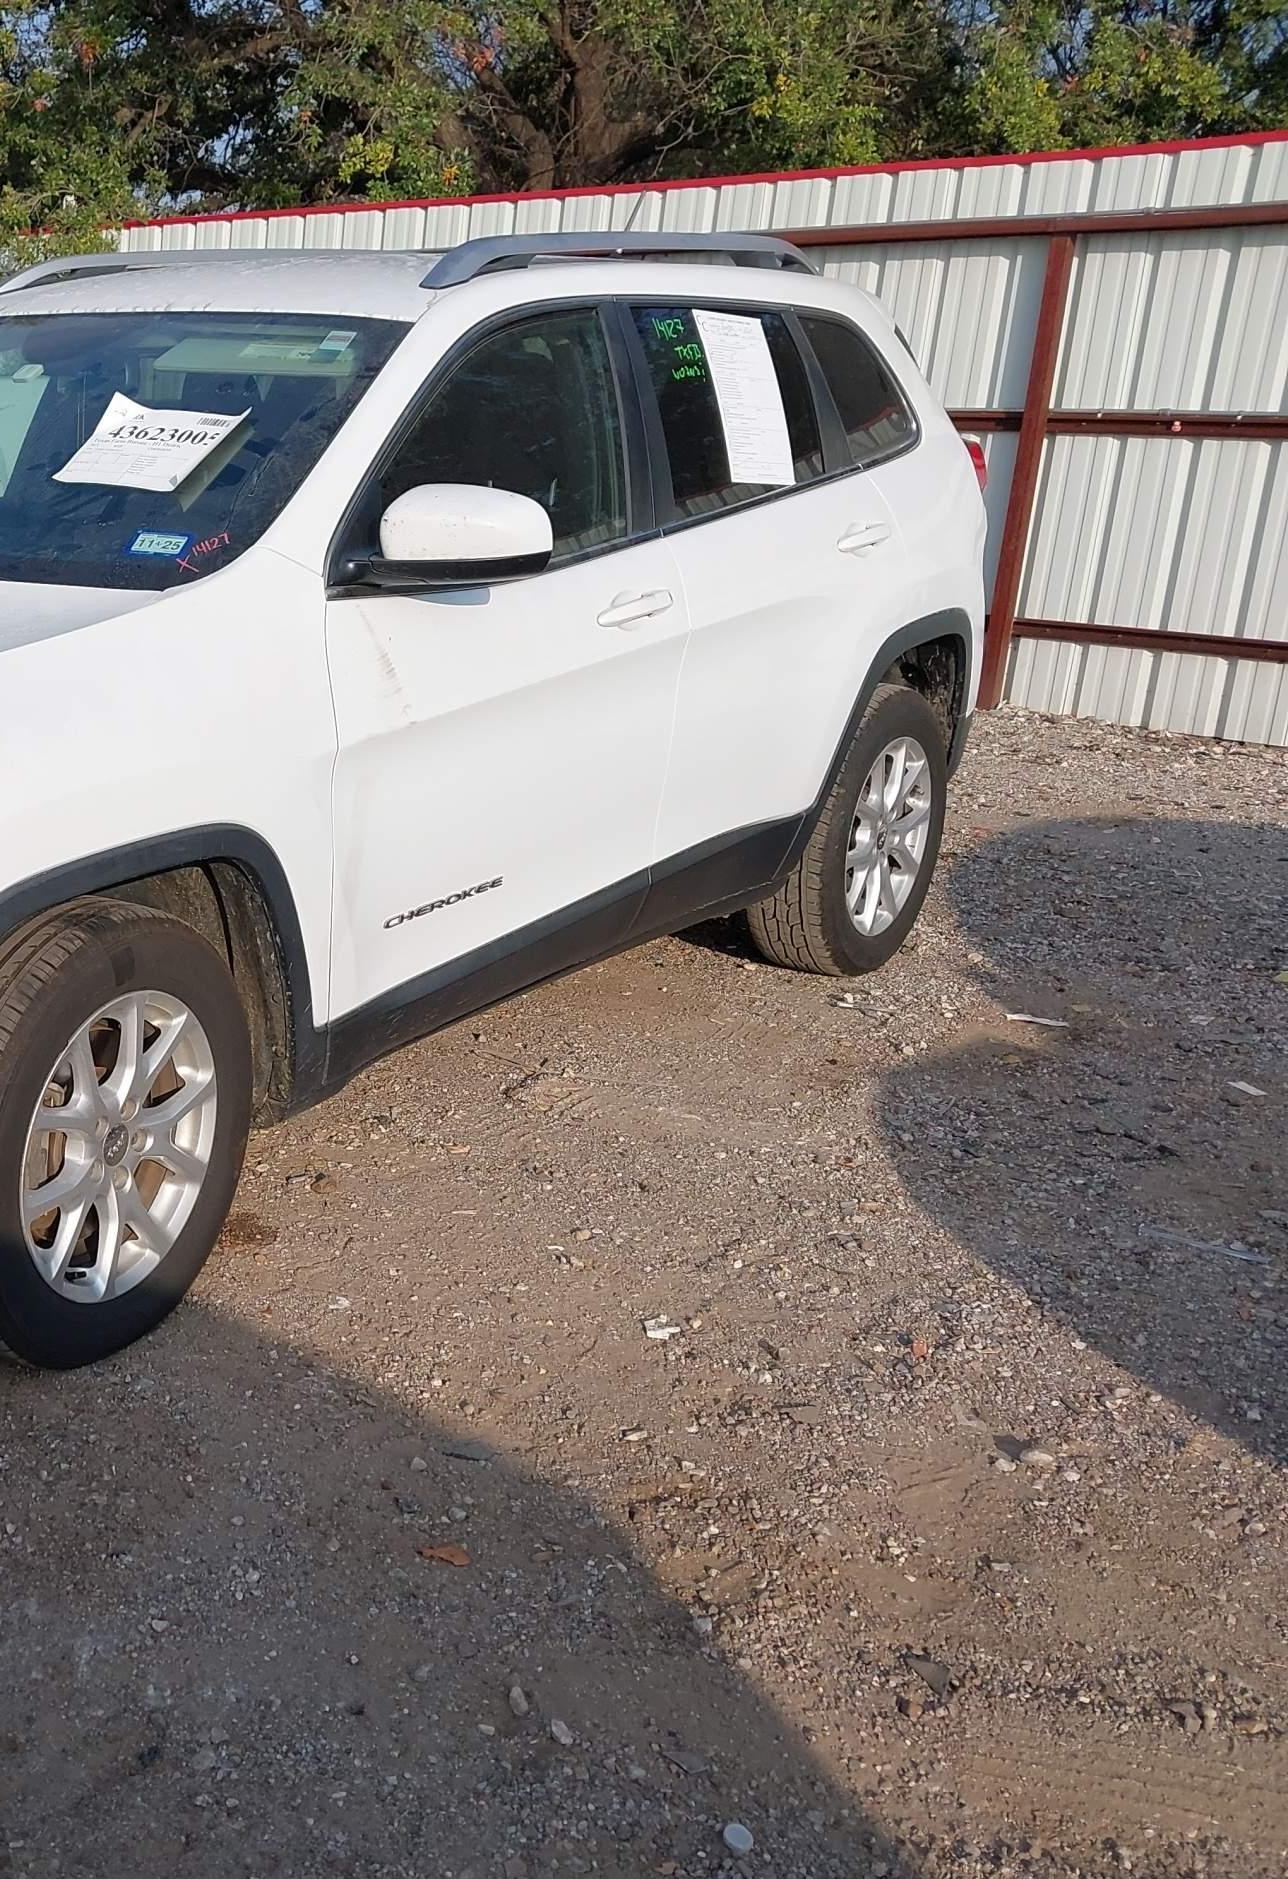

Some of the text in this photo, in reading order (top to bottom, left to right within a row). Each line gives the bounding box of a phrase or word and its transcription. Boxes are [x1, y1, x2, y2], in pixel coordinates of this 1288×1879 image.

[162, 541, 182, 551] 25
[192, 532, 231, 557] 14127
[383, 875, 504, 929] CHEROKEE
